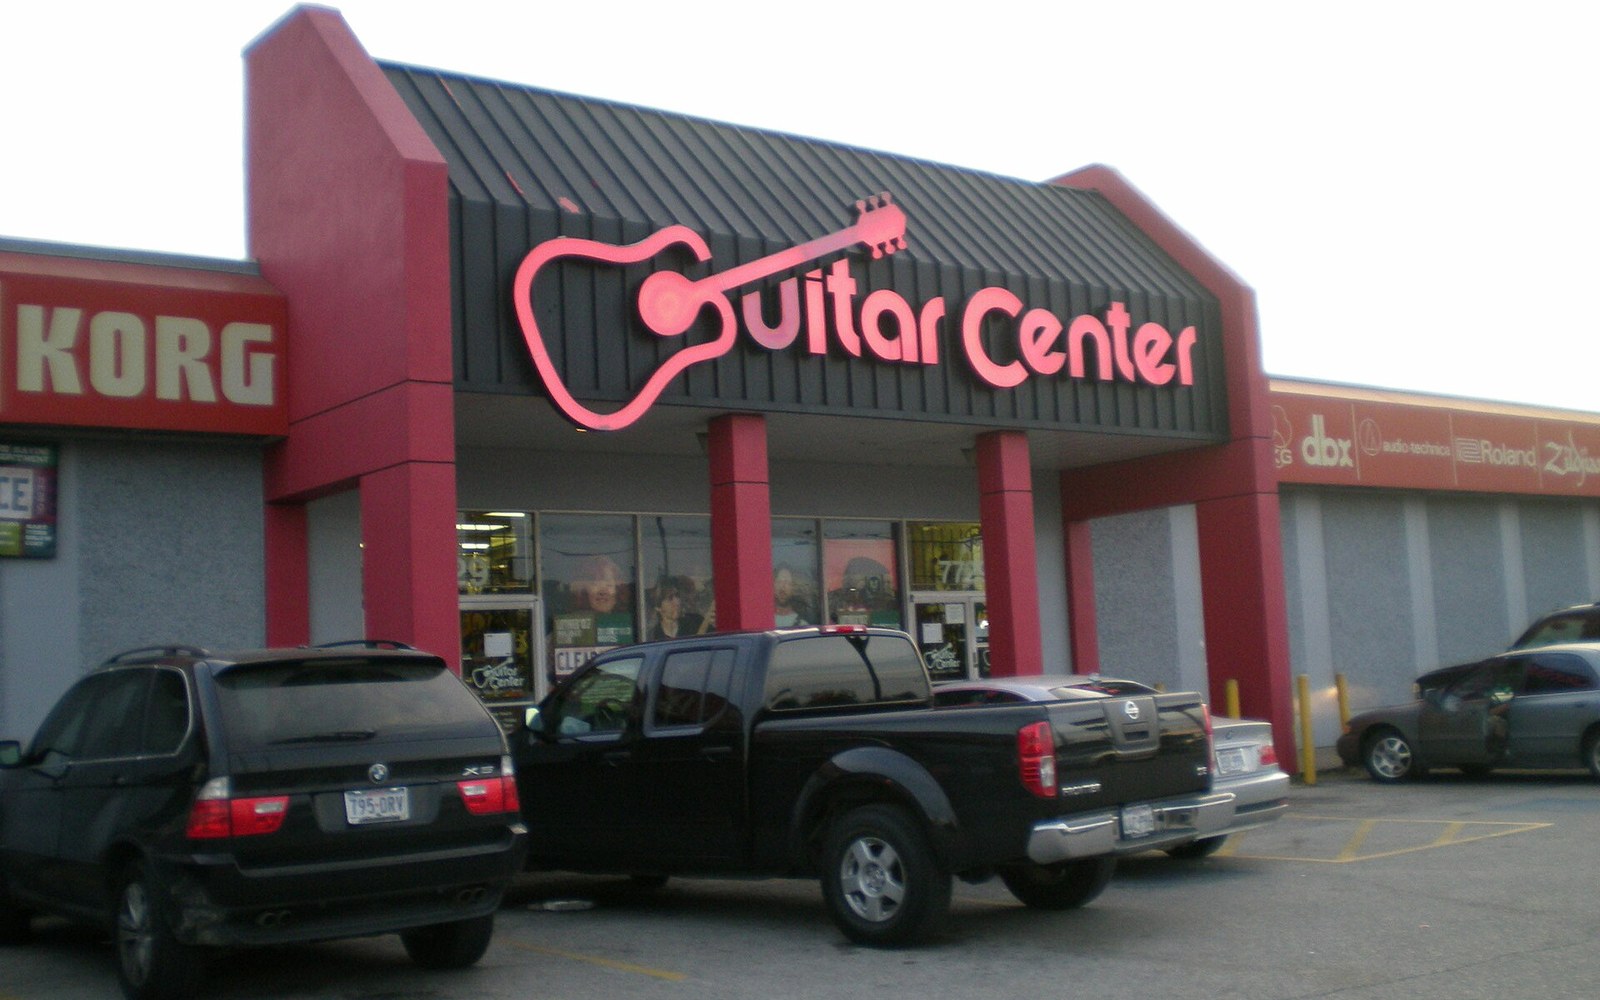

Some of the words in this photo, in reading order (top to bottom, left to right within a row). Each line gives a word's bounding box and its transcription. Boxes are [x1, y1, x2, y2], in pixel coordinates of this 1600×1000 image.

[513, 192, 946, 432] Guitar
[962, 286, 1197, 388] Center
[17, 304, 275, 406] KORG
[1302, 413, 1354, 468] dbx
[1480, 439, 1537, 468] Roland
